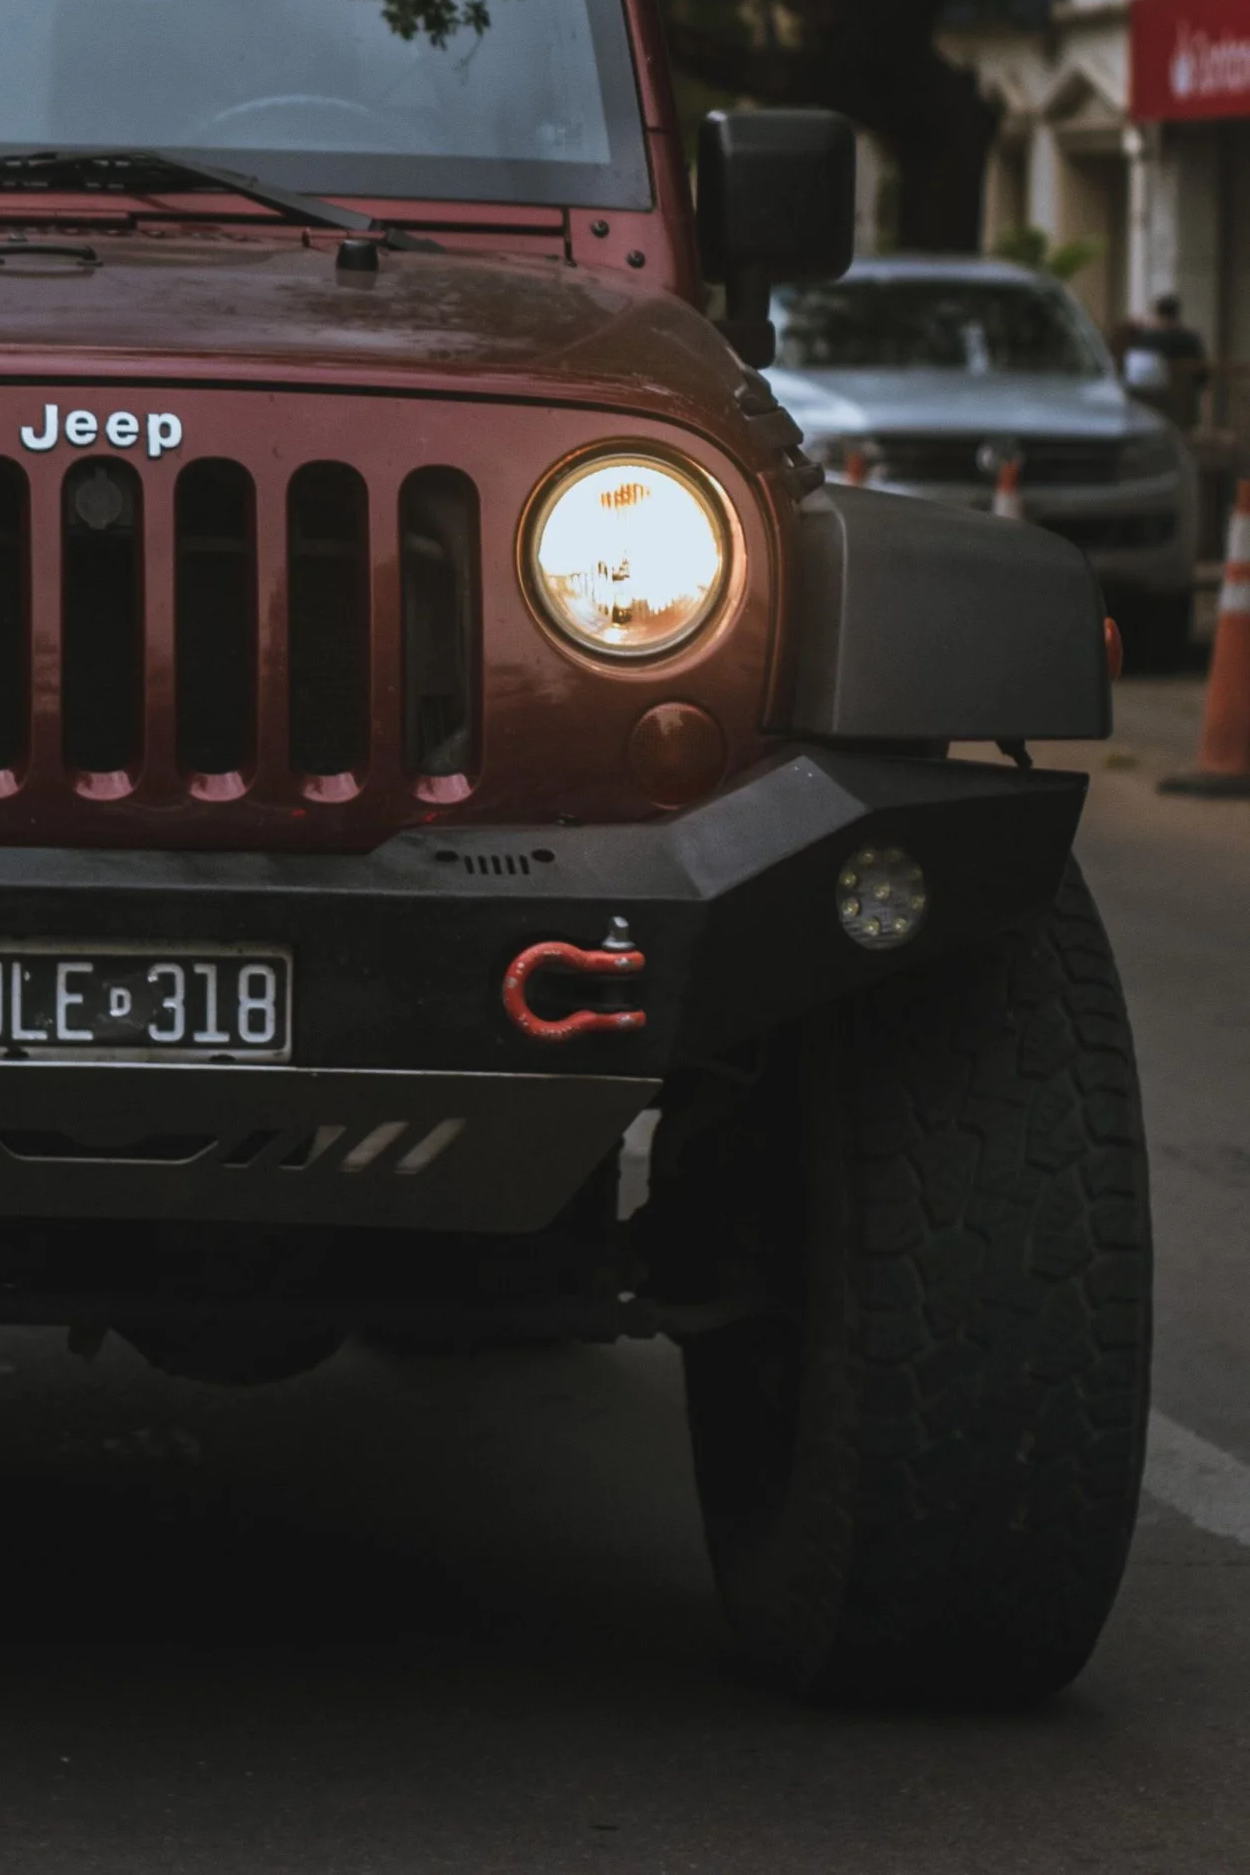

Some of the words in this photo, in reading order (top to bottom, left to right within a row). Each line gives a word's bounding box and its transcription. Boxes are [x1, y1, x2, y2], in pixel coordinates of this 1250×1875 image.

[20, 403, 183, 457] Jeep
[109, 987, 132, 1018] D
[147, 964, 277, 1044] 318
